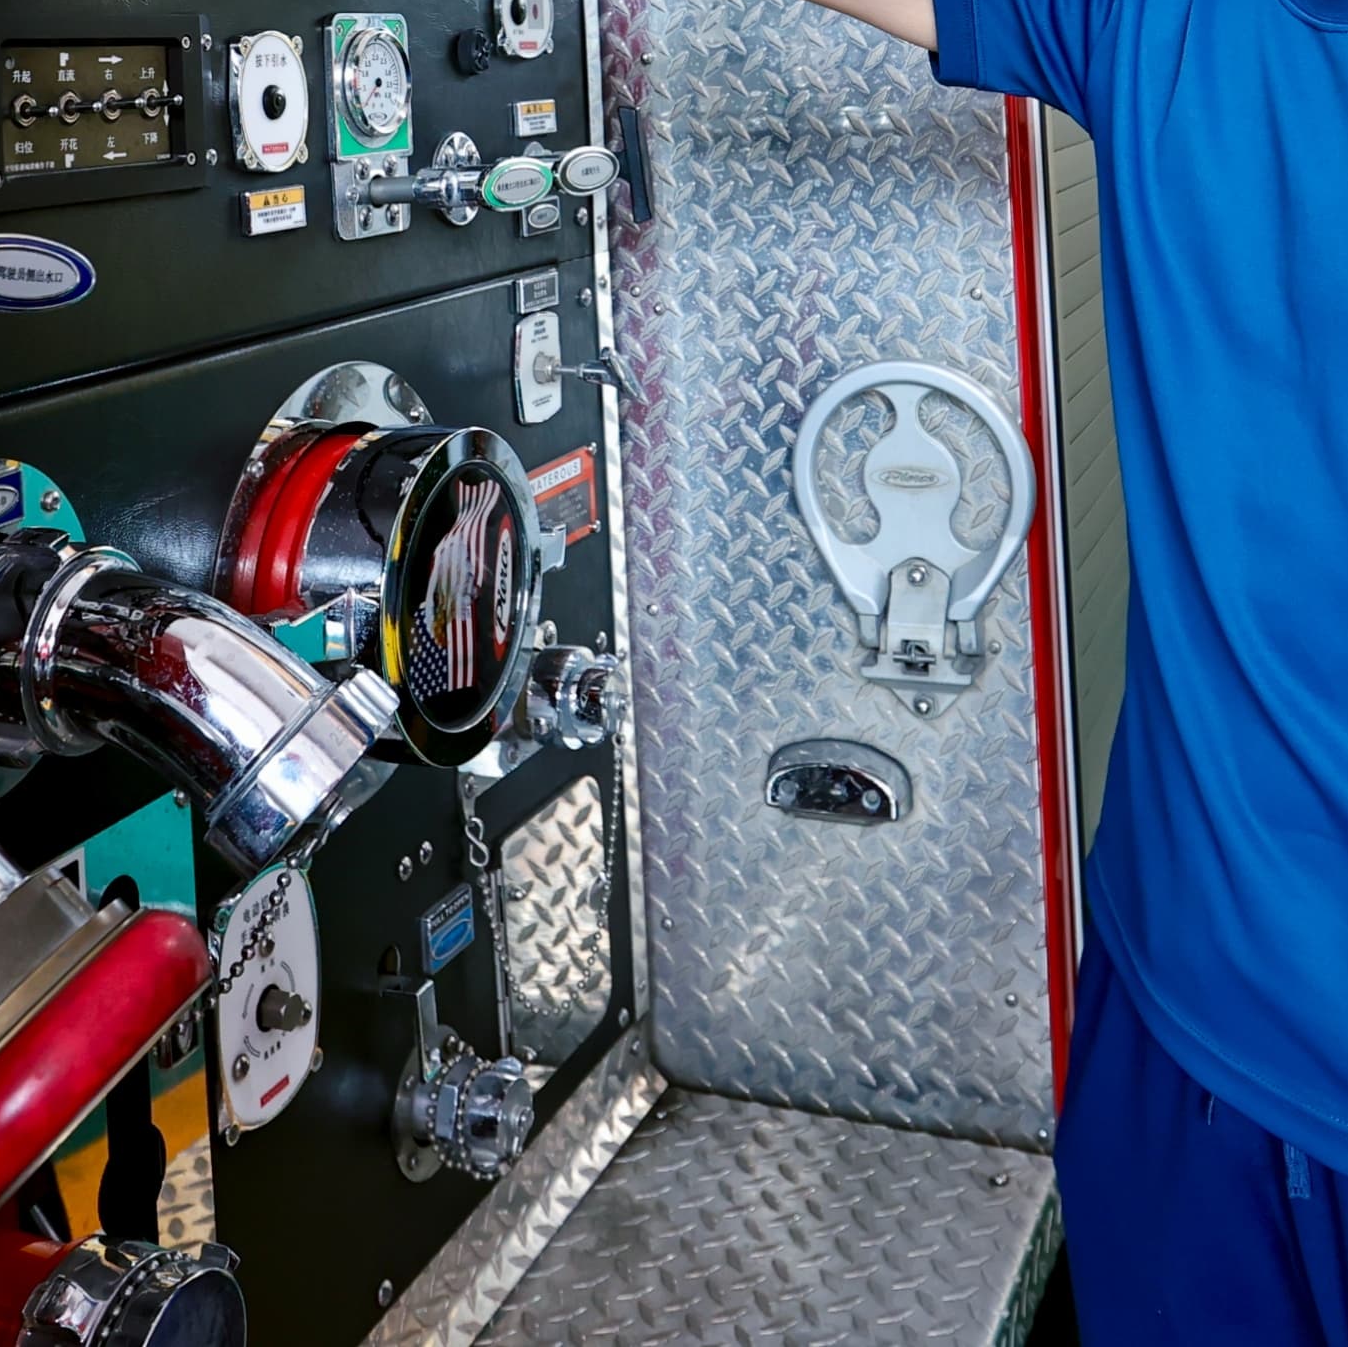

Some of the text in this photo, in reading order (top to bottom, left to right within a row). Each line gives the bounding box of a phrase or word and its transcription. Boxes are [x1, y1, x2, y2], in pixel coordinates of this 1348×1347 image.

[255, 52, 287, 69] 按下引水
[12, 67, 155, 84] 升起 直流 右 上升
[14, 132, 158, 154] 归位 开花 左 下降
[496, 539, 509, 632] Pierce
